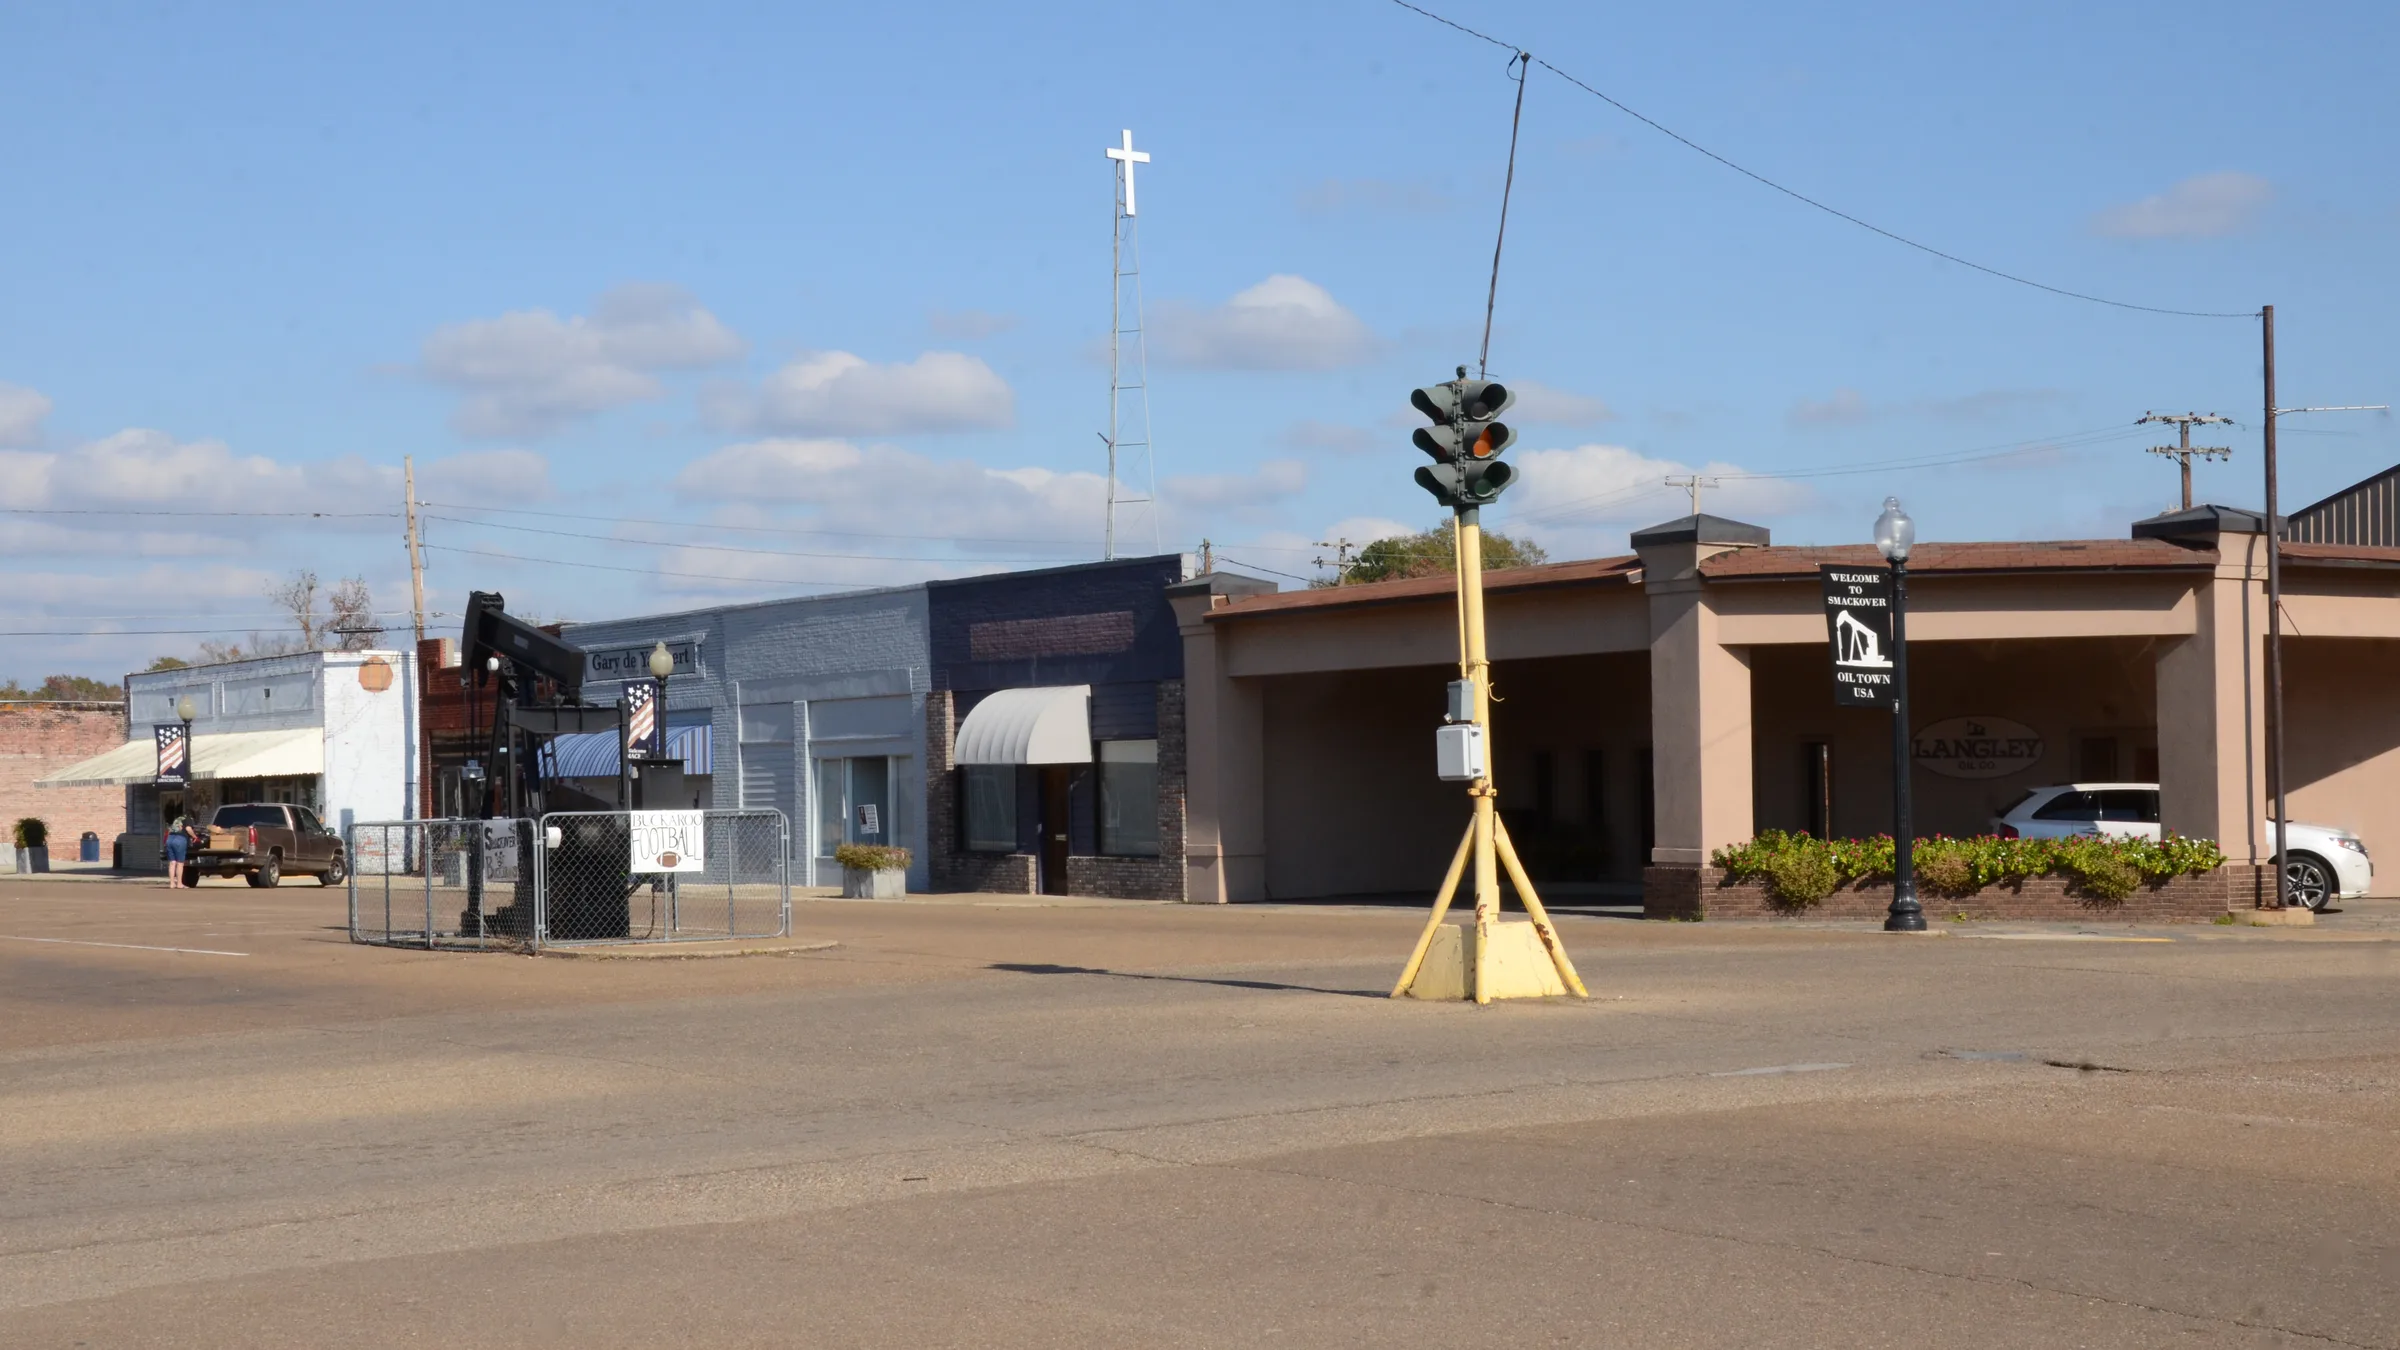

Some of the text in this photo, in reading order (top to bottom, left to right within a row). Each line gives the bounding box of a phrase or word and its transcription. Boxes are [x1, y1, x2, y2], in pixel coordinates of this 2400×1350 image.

[1830, 573, 1880, 583] WELCOME
[1848, 585, 1863, 595] TO
[1827, 596, 1887, 607] SMACKOVER
[592, 654, 620, 673] Gary
[623, 651, 637, 669] de
[1837, 671, 1891, 684] OIL TOWN
[1853, 687, 1875, 698] USA
[1911, 739, 2040, 758] LANGLEY
[1958, 760, 1976, 770] OIL
[632, 813, 703, 827] BUCKAROO
[631, 826, 702, 865] FOOTBALL
